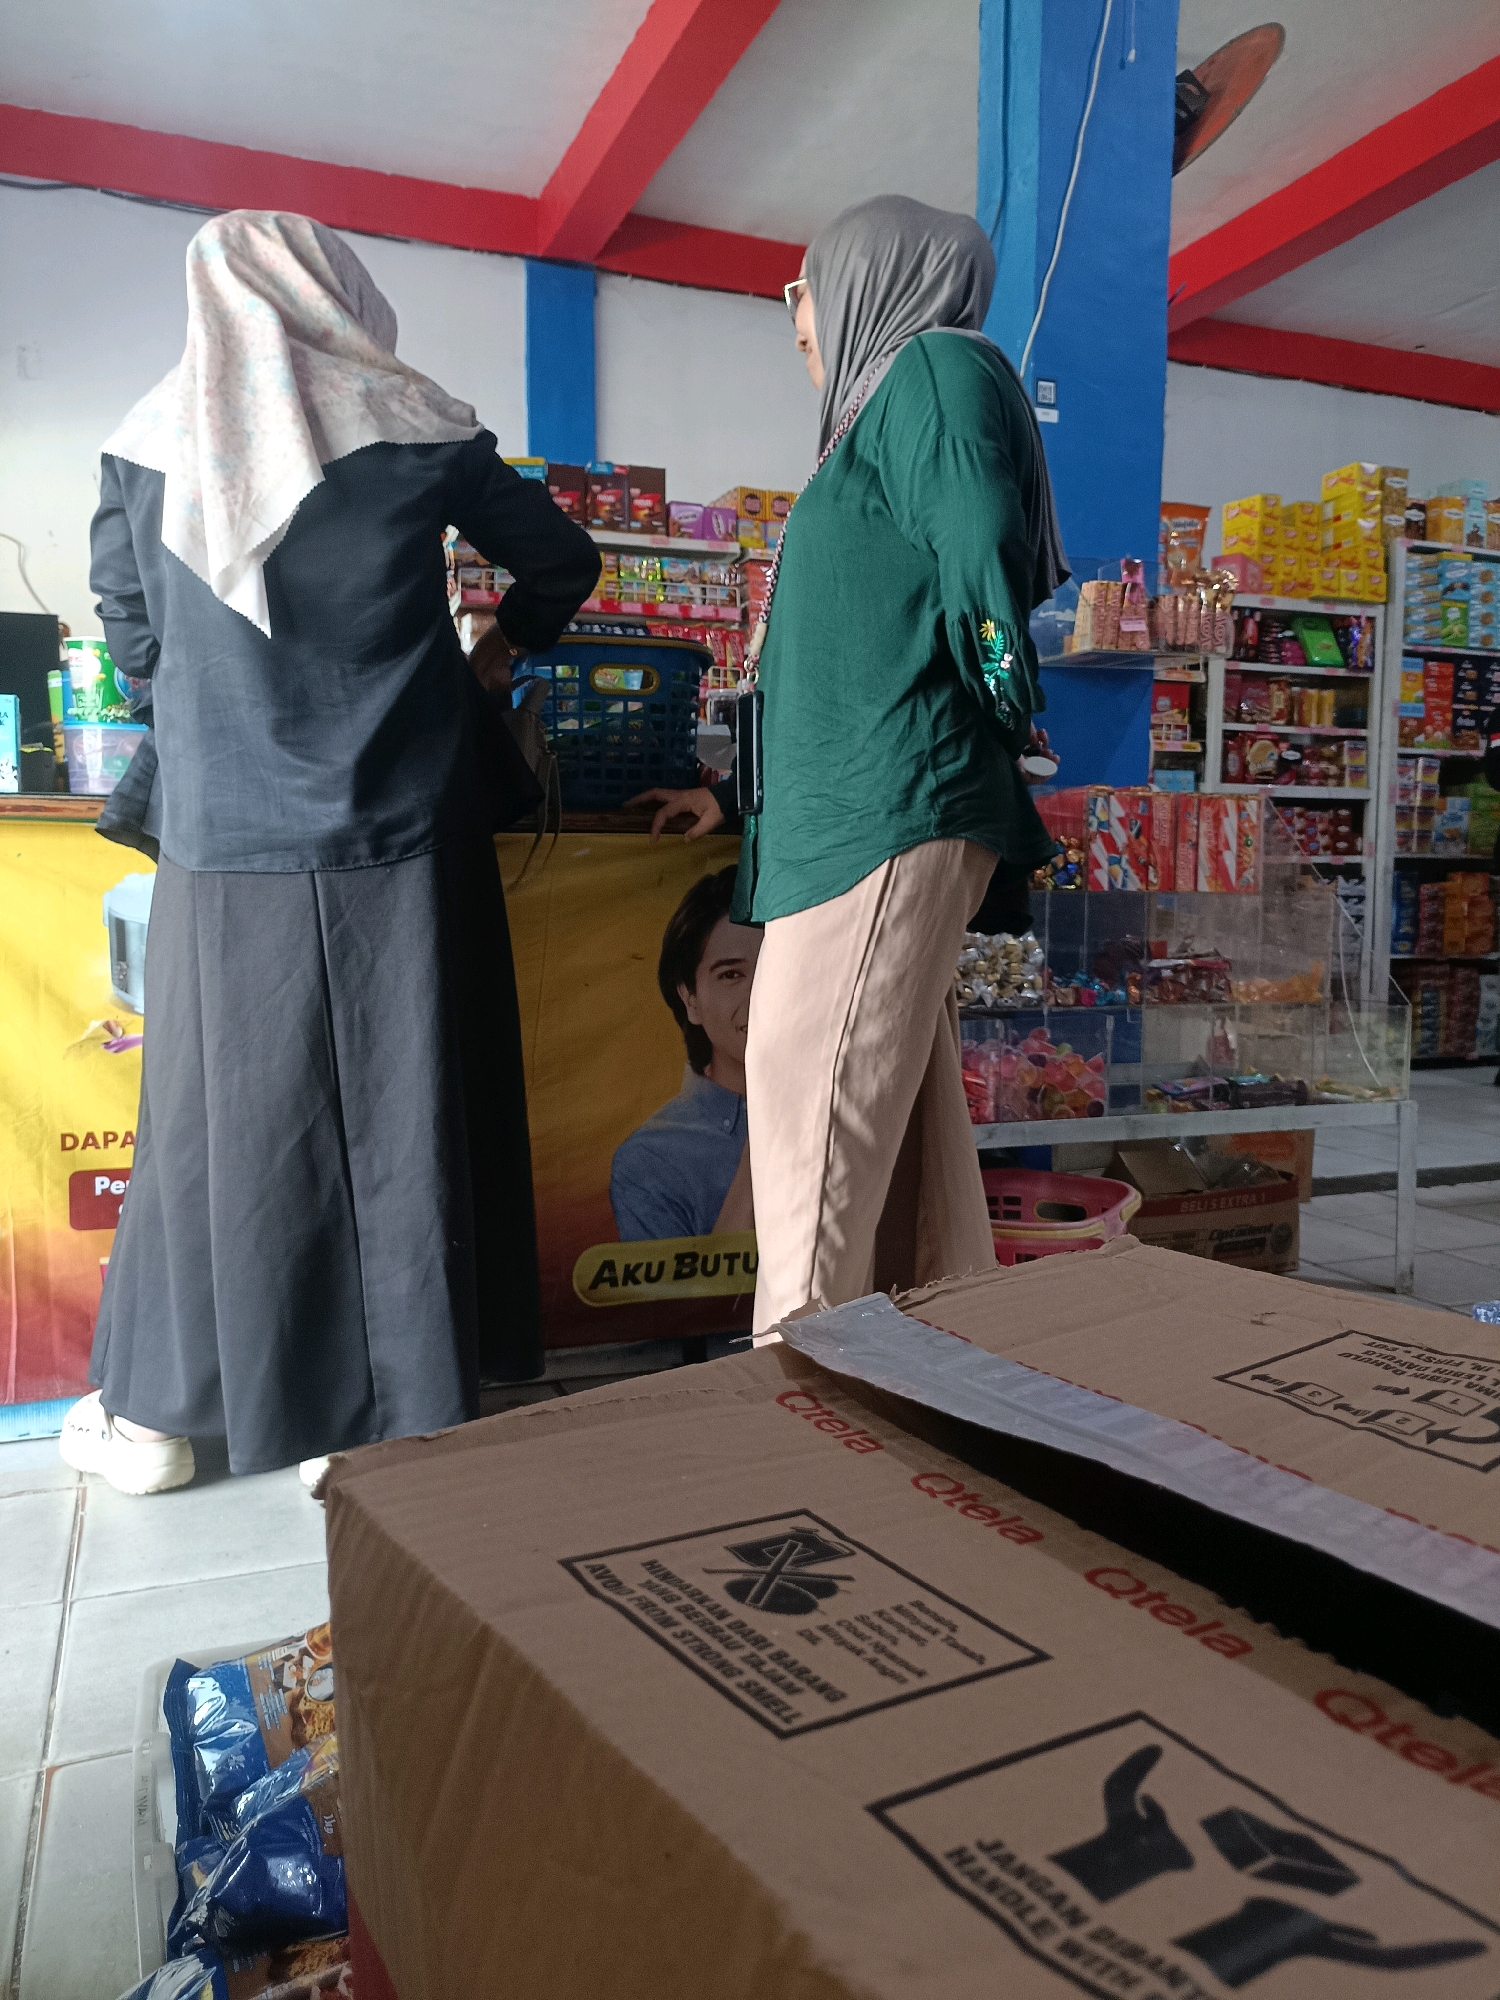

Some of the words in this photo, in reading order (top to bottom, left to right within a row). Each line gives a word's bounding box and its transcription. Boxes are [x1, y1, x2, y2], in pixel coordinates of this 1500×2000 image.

[1218, 1195, 1257, 1209] EXTRA
[588, 1259, 666, 1291] AKU
[1337, 1352, 1408, 1377] DAHULU
[1361, 1350, 1426, 1372] DAHULU
[1413, 1352, 1463, 1368] FIRST
[1431, 1366, 1490, 1382] LEBIH
[1409, 1371, 1463, 1386] LEBIH
[1306, 1389, 1323, 1398] 3
[1449, 1397, 1461, 1405] 1
[775, 1390, 885, 1454] Qtela
[1394, 1416, 1408, 1425] 2
[910, 1472, 1045, 1545] Qtela
[1083, 1567, 1254, 1659] Qtela
[584, 1562, 636, 1596] AVOID
[625, 1595, 682, 1629] FROM
[671, 1628, 744, 1679] STRONG
[735, 1678, 802, 1724] SMELL
[637, 1578, 683, 1604] YANG
[674, 1604, 746, 1651] BERBAU
[739, 1652, 804, 1696] TAJAM
[640, 1558, 733, 1621] HINDARKAN
[725, 1619, 775, 1651] DARI
[766, 1650, 848, 1702] BARANG
[974, 1839, 1092, 1929] JANGAN
[943, 1846, 1060, 1940] HANDLE
[1056, 1937, 1144, 1990] WITH
